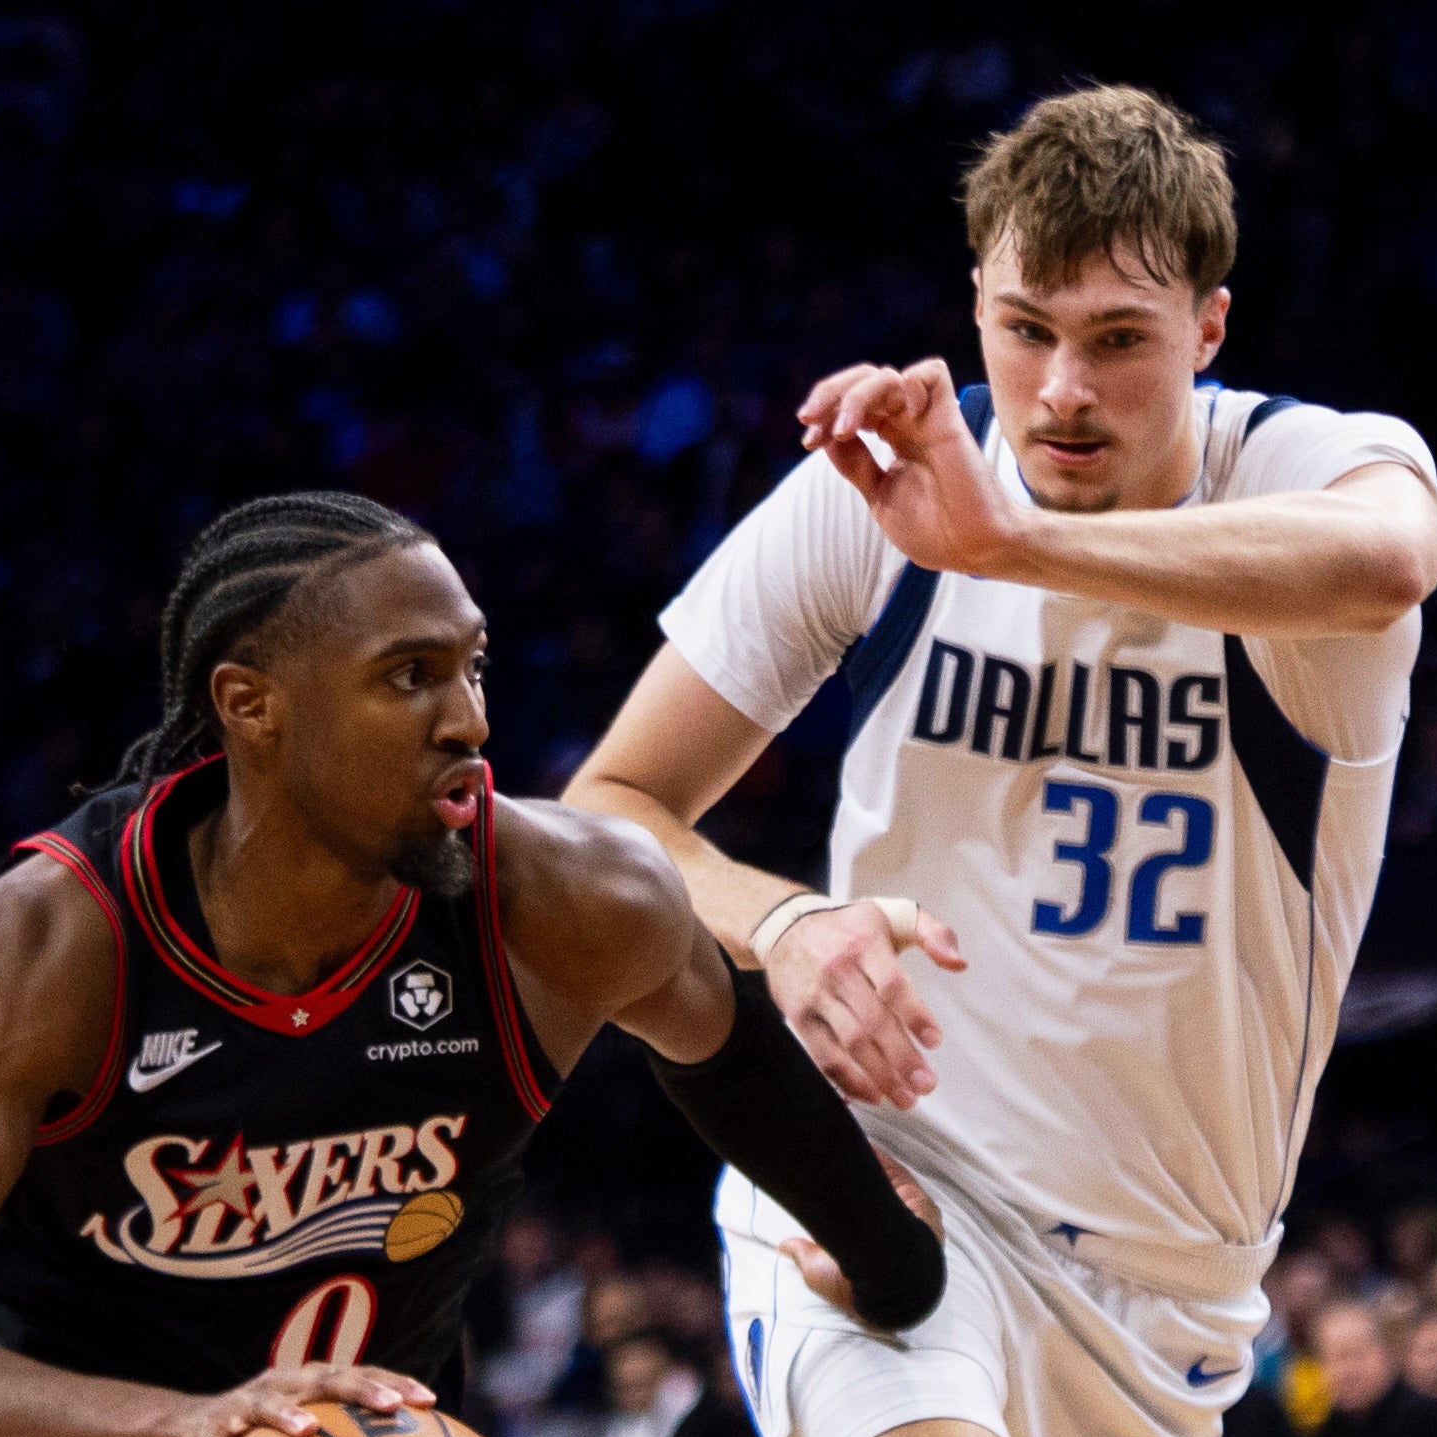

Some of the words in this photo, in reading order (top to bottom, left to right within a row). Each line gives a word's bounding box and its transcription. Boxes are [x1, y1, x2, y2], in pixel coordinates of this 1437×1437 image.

[911, 636, 1224, 772] DALLAS
[1030, 779, 1216, 946] 32
[141, 1028, 199, 1068] NIKE
[367, 1039, 480, 1062] crypto.com
